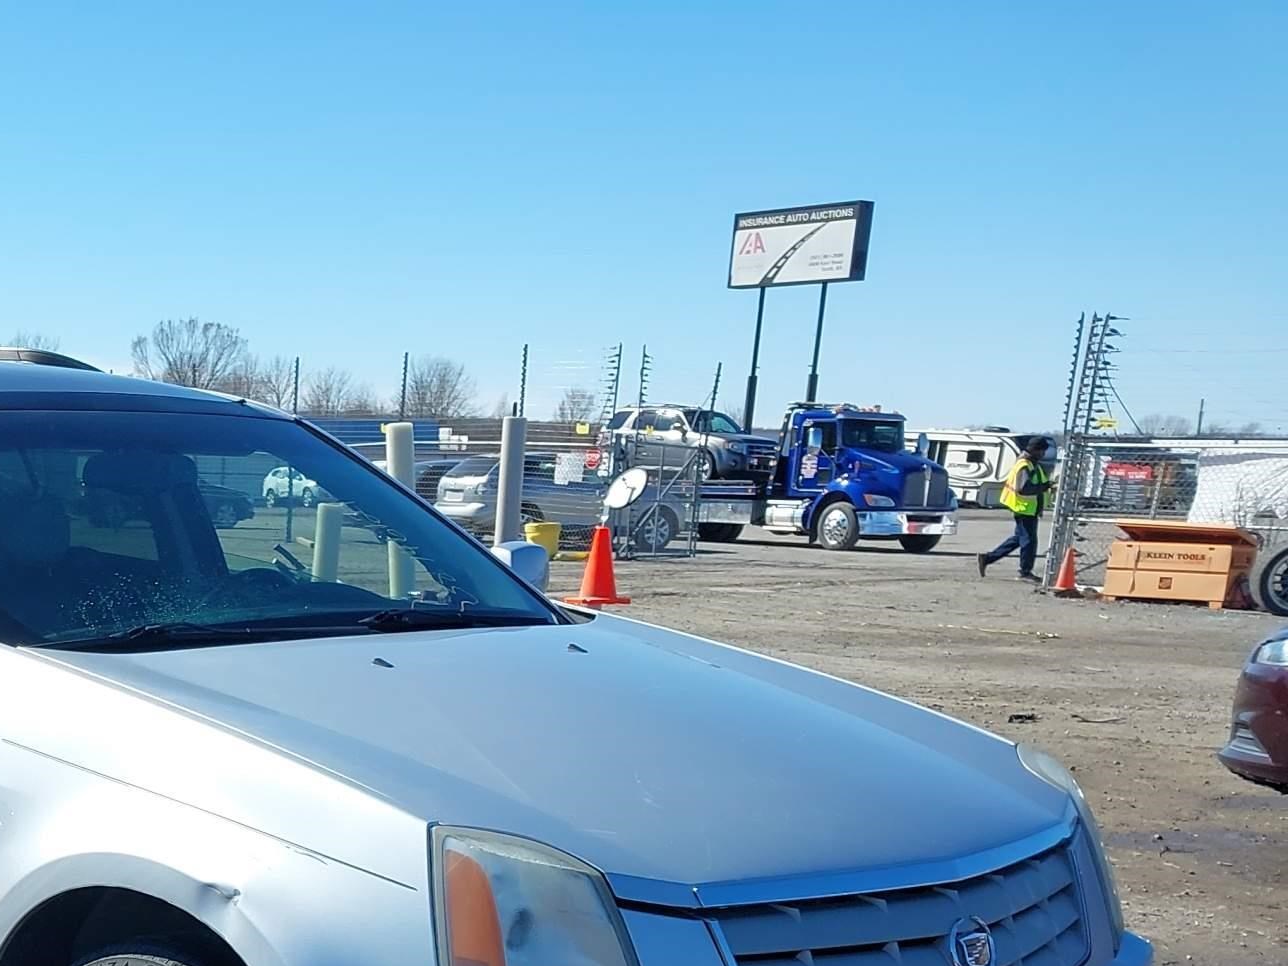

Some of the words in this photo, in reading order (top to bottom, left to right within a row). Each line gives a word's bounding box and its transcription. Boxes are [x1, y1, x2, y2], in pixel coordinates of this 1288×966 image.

[738, 214, 785, 228] INSURANCE
[785, 212, 809, 223] AUTO
[810, 207, 854, 221] AUCTIONS
[1146, 552, 1174, 560] KLEIN
[1177, 553, 1206, 561] TOOLS
